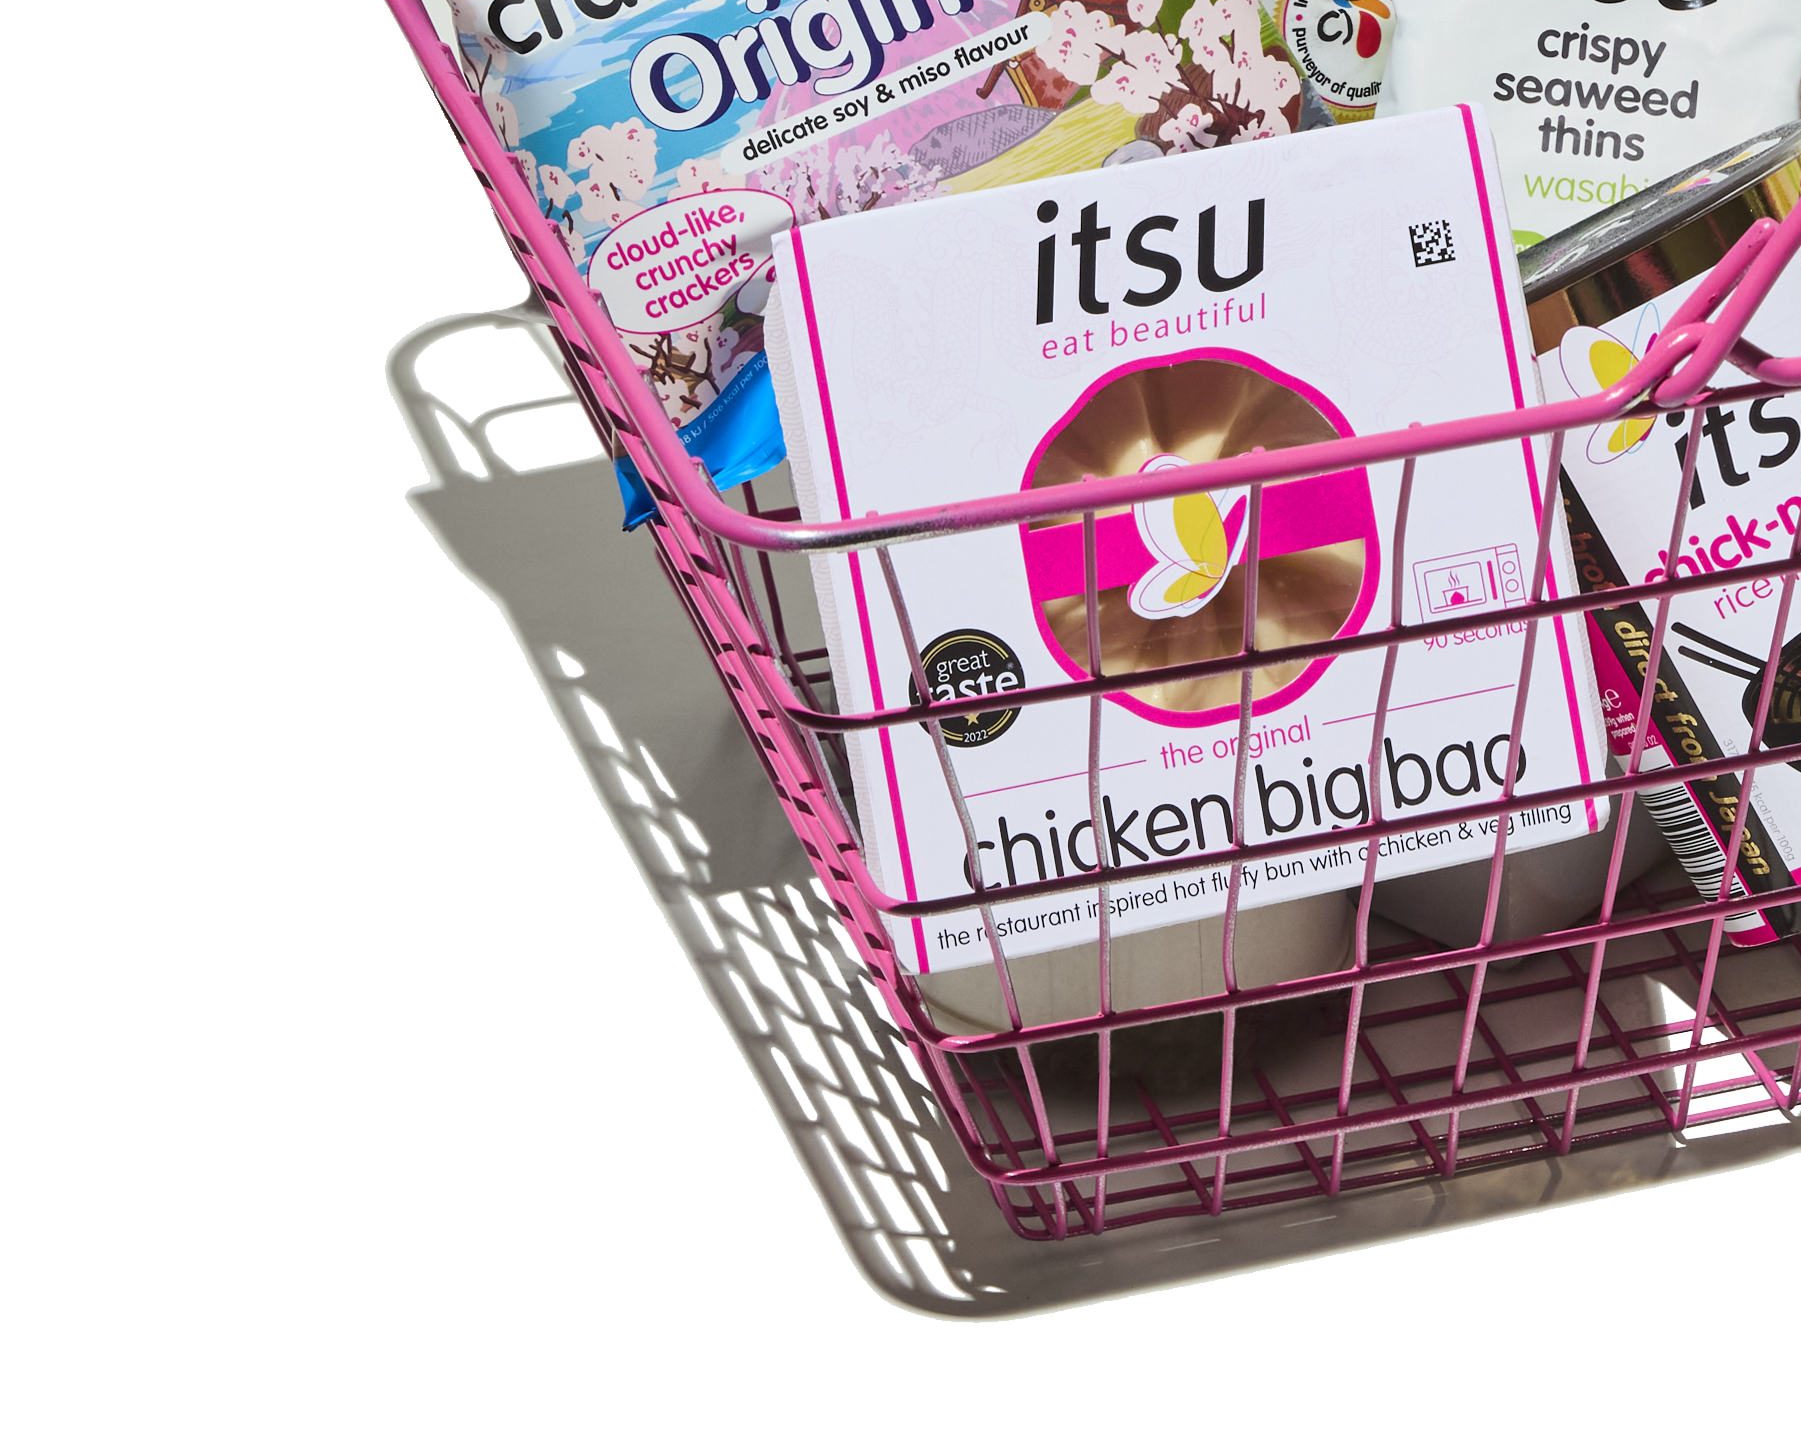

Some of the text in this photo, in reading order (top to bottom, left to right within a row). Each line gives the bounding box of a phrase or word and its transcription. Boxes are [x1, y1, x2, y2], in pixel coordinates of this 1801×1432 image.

[1292, 27, 1383, 101] purveyor of qualit
[1537, 23, 1666, 77] crispy
[742, 23, 1030, 162] delicate soy & miso flavour
[1493, 71, 1699, 119] seaweed
[1538, 115, 1645, 161] thins
[1524, 174, 1649, 205] wasab
[607, 204, 745, 270] cloud-like,
[635, 235, 737, 290] crunchy
[1035, 197, 1266, 325] itsu
[645, 251, 755, 318] crackers
[1041, 292, 1267, 360] eat beautiful
[723, 384, 741, 406] kcal
[1713, 575, 1773, 619] rice
[925, 670, 1020, 705] aste
[936, 650, 991, 683] great
[963, 729, 989, 744] 2022
[1160, 715, 1312, 769] the orginal
[963, 733, 1527, 890] chicken big bao
[1753, 790, 1796, 862] kcal per 100g
[938, 925, 971, 950] the
[1174, 875, 1206, 898] hot
[1211, 864, 1259, 894] flufy
[1265, 858, 1305, 882] bun
[1309, 846, 1352, 872] with
[1378, 822, 1452, 857] chicken
[1458, 821, 1475, 840] &
[1519, 804, 1572, 829] filling
